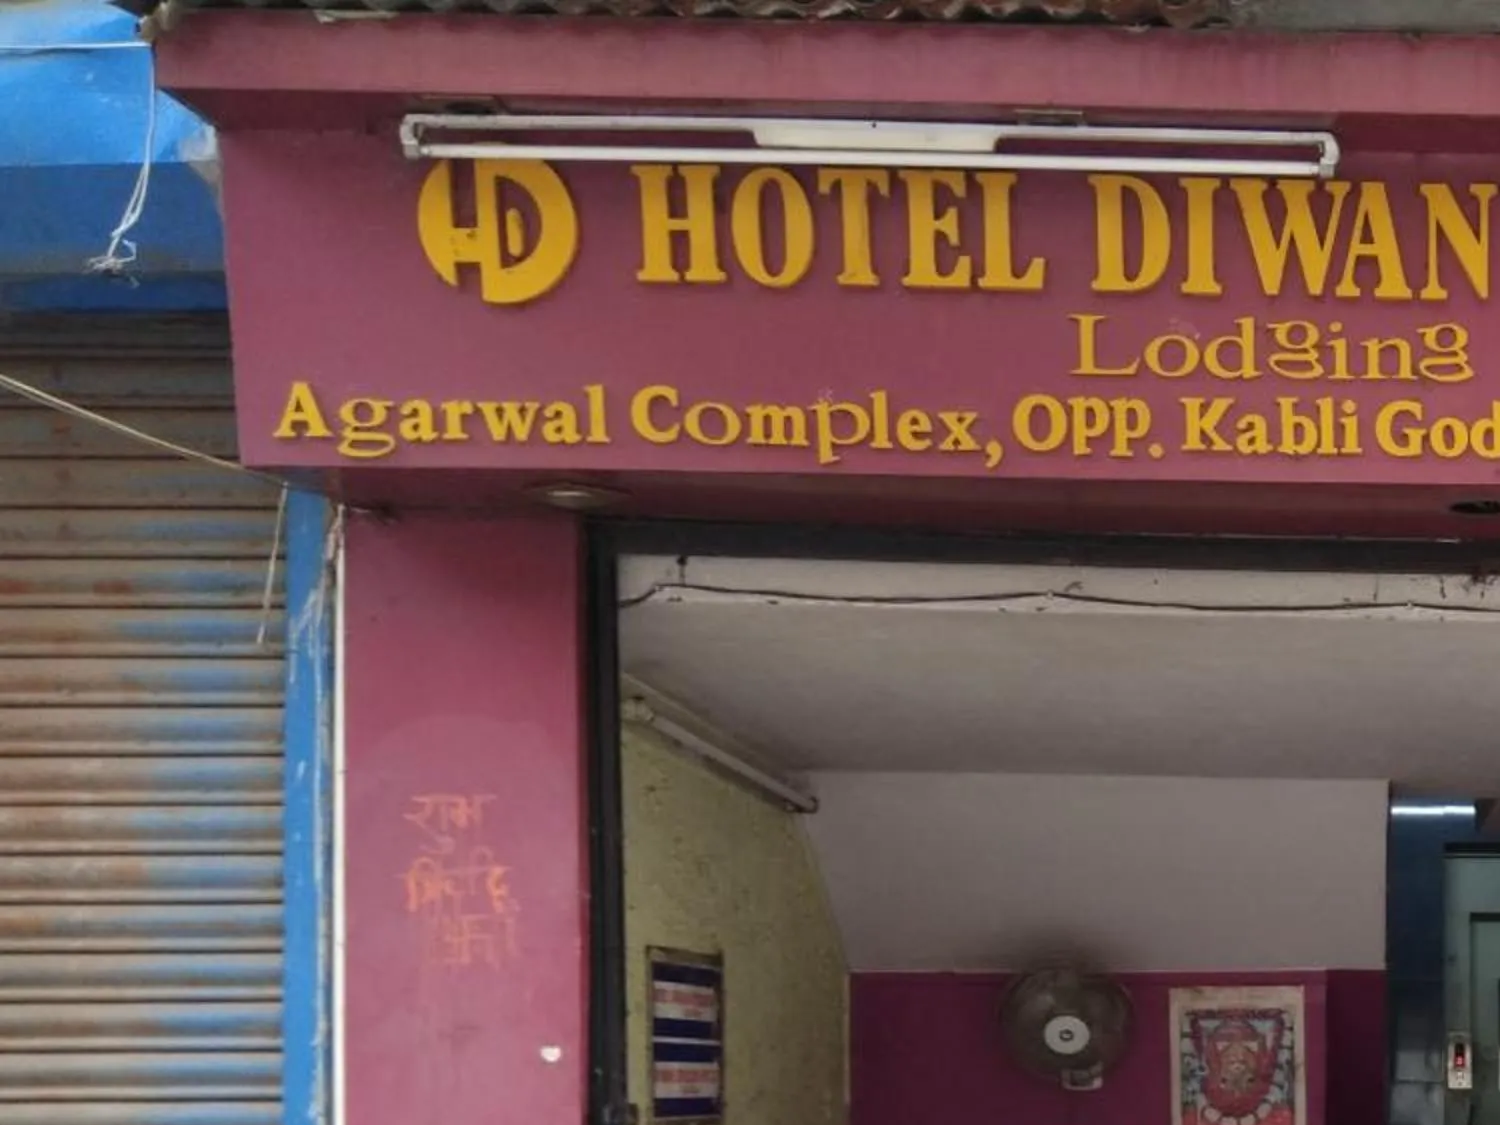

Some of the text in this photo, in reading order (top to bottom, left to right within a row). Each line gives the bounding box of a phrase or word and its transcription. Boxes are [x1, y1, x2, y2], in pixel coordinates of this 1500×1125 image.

[634, 164, 1047, 292] HOTEL
[1090, 174, 1497, 303] DIWAN
[1070, 313, 1474, 384] Lodging
[274, 382, 610, 457] Agarwal
[629, 384, 1003, 469] Complex,
[1180, 394, 1362, 456] Kabli
